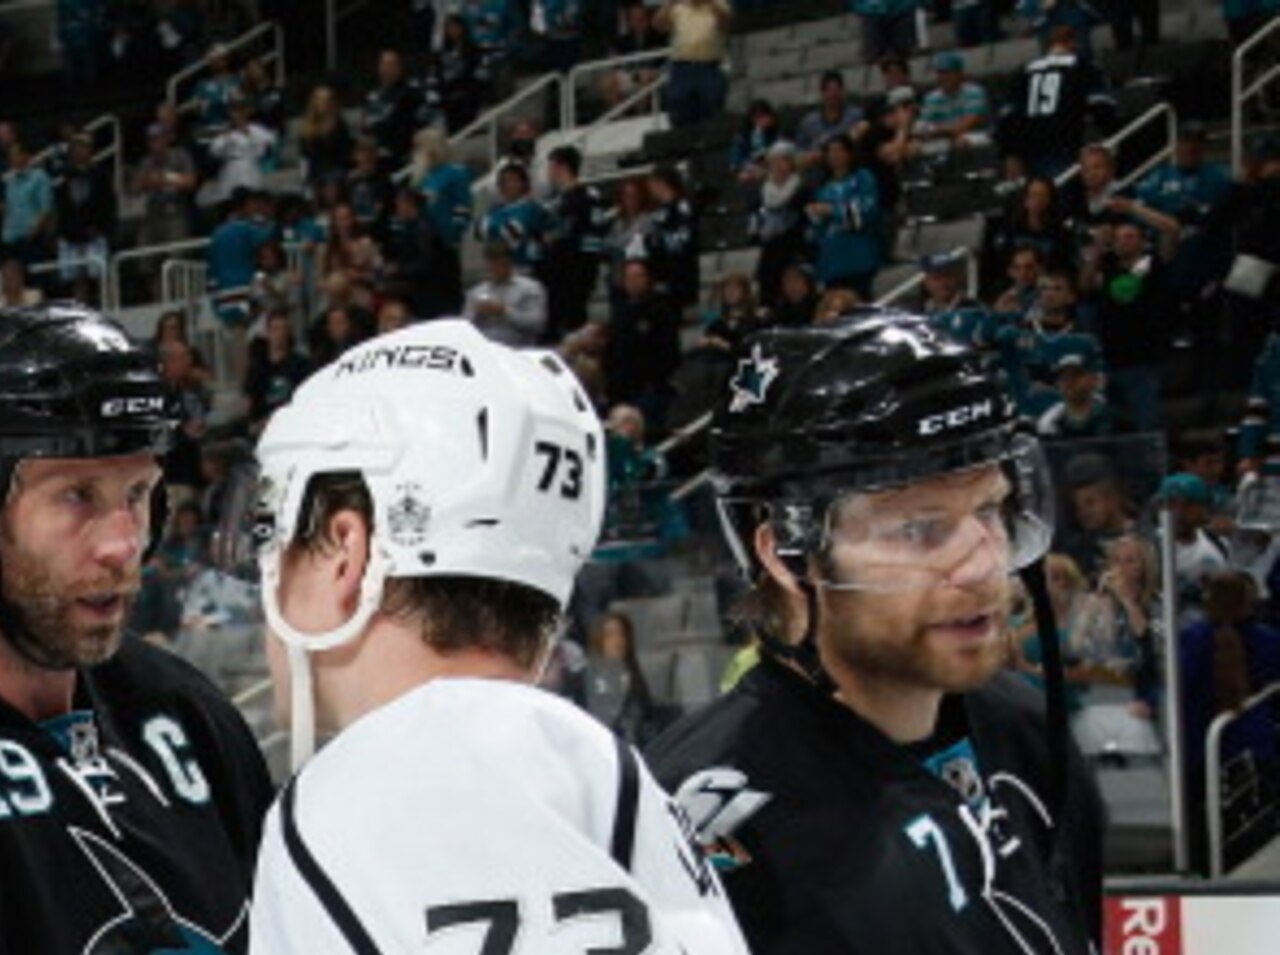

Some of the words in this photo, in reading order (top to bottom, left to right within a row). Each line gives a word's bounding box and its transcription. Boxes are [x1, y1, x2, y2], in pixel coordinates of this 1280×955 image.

[919, 399, 991, 435] CCM
[534, 440, 584, 501] 73
[143, 714, 211, 803] C
[904, 814, 968, 912] 7
